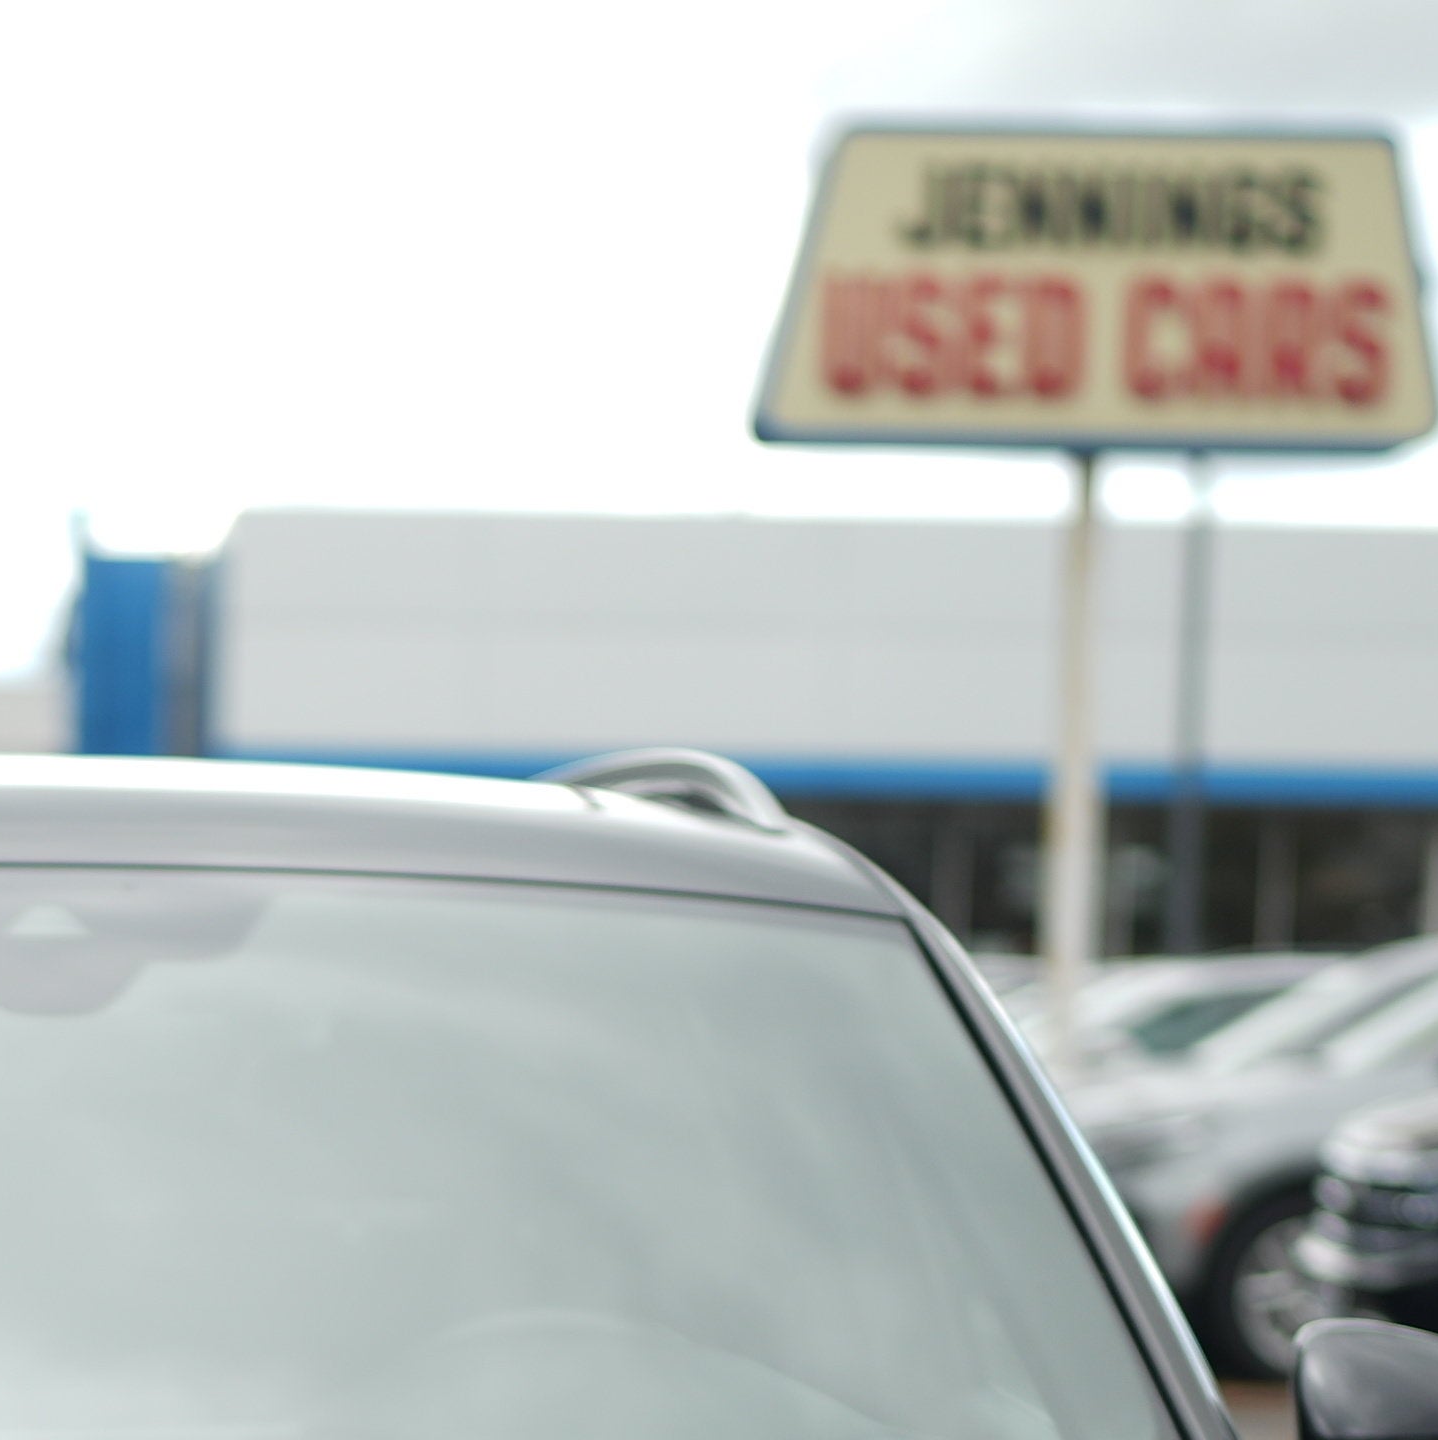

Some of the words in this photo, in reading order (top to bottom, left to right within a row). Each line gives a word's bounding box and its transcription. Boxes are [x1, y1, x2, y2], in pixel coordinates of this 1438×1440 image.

[898, 162, 1328, 256] JENNINGS
[816, 272, 1086, 408] USED
[1121, 276, 1390, 412] CARS
